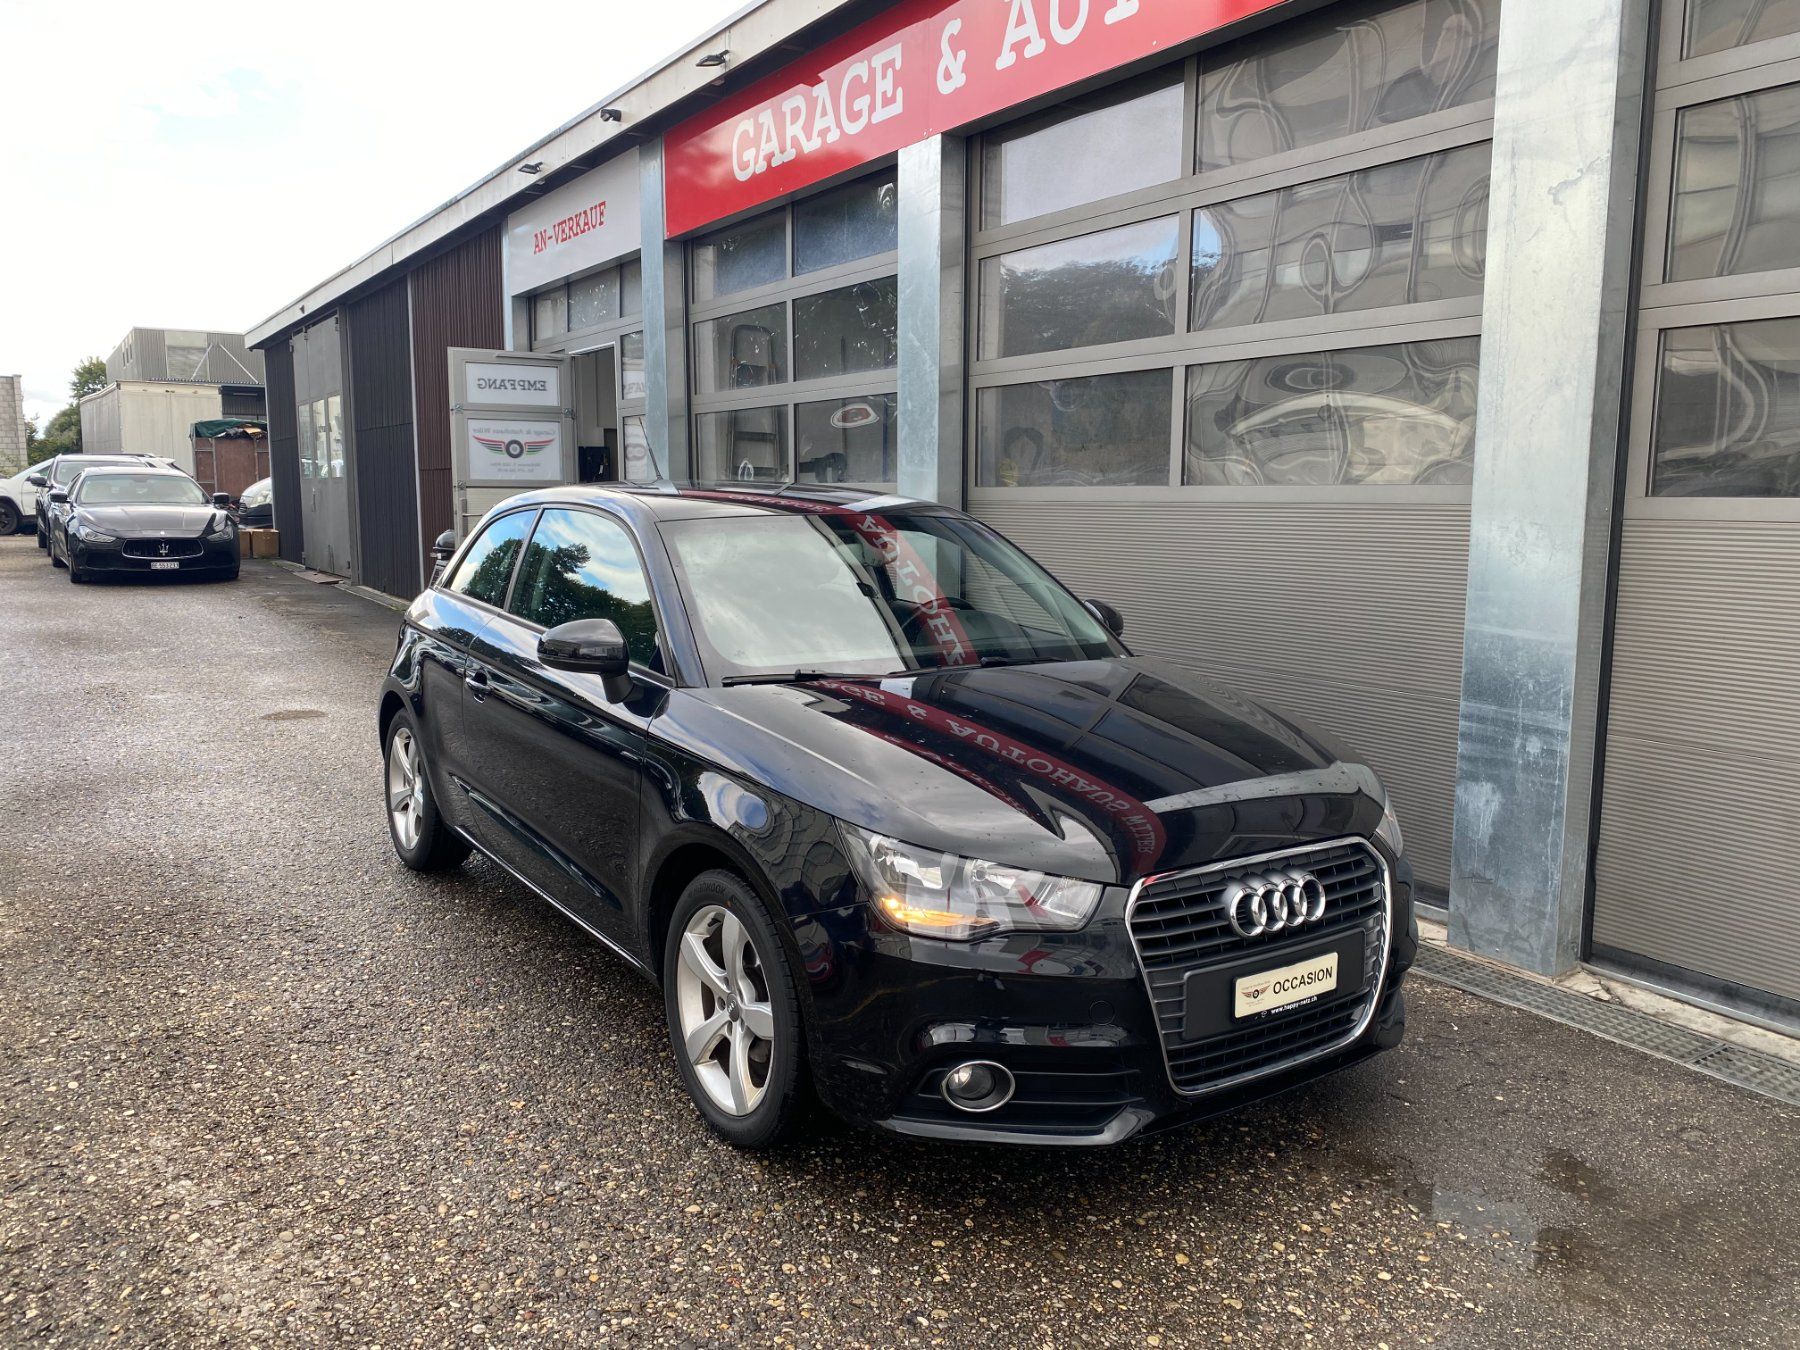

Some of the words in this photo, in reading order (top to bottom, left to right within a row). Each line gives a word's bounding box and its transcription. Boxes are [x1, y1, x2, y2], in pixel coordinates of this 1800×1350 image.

[732, 43, 903, 182] GARAGE
[936, 18, 967, 95] &
[534, 201, 607, 256] AN-VERKAUF
[1273, 966, 1333, 995] OCCASION
